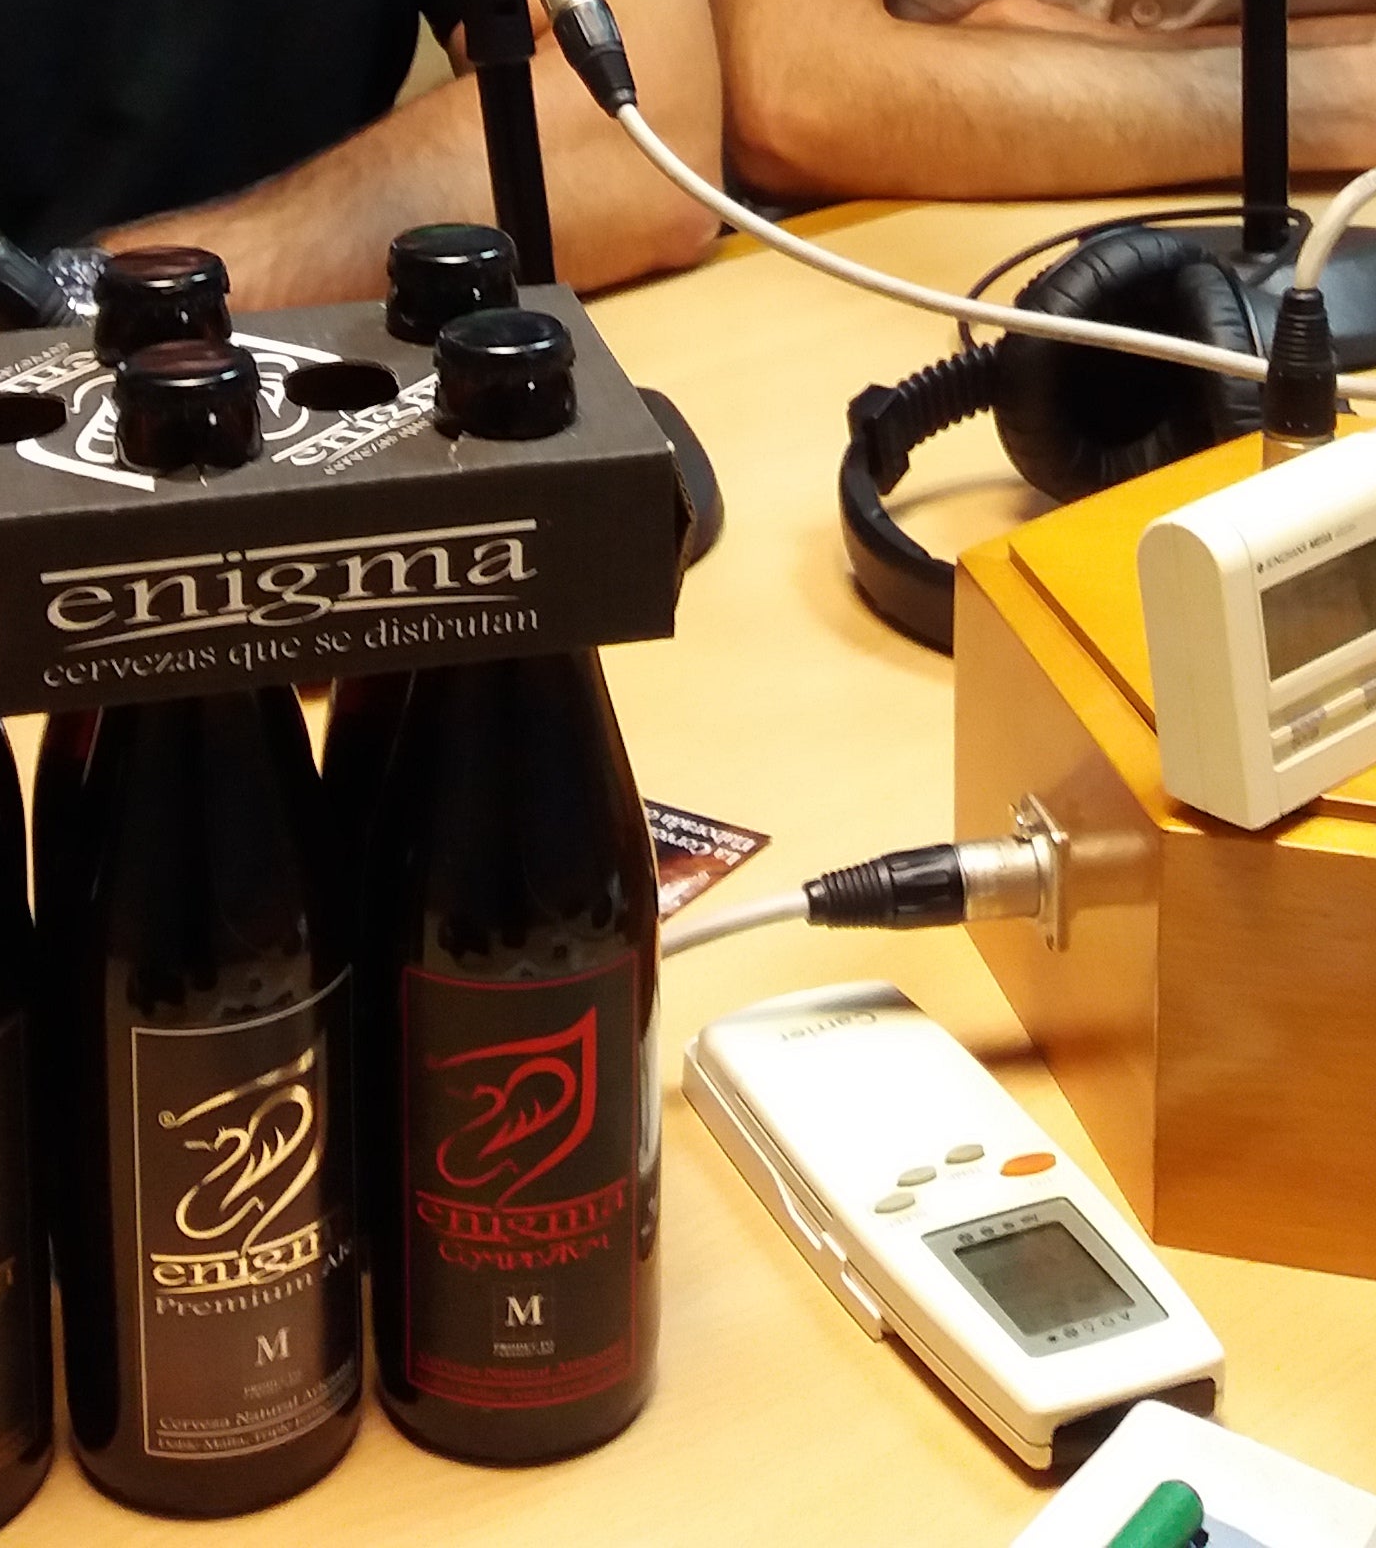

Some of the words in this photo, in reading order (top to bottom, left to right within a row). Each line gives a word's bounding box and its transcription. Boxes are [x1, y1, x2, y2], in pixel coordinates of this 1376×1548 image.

[45, 537, 539, 633] enigma
[42, 644, 217, 688] cervezas
[228, 636, 302, 672] que
[314, 630, 352, 656] se
[364, 608, 539, 649] disfrutan
[155, 1271, 315, 1317] Premium
[505, 1293, 544, 1327] M
[254, 1326, 291, 1367] M
